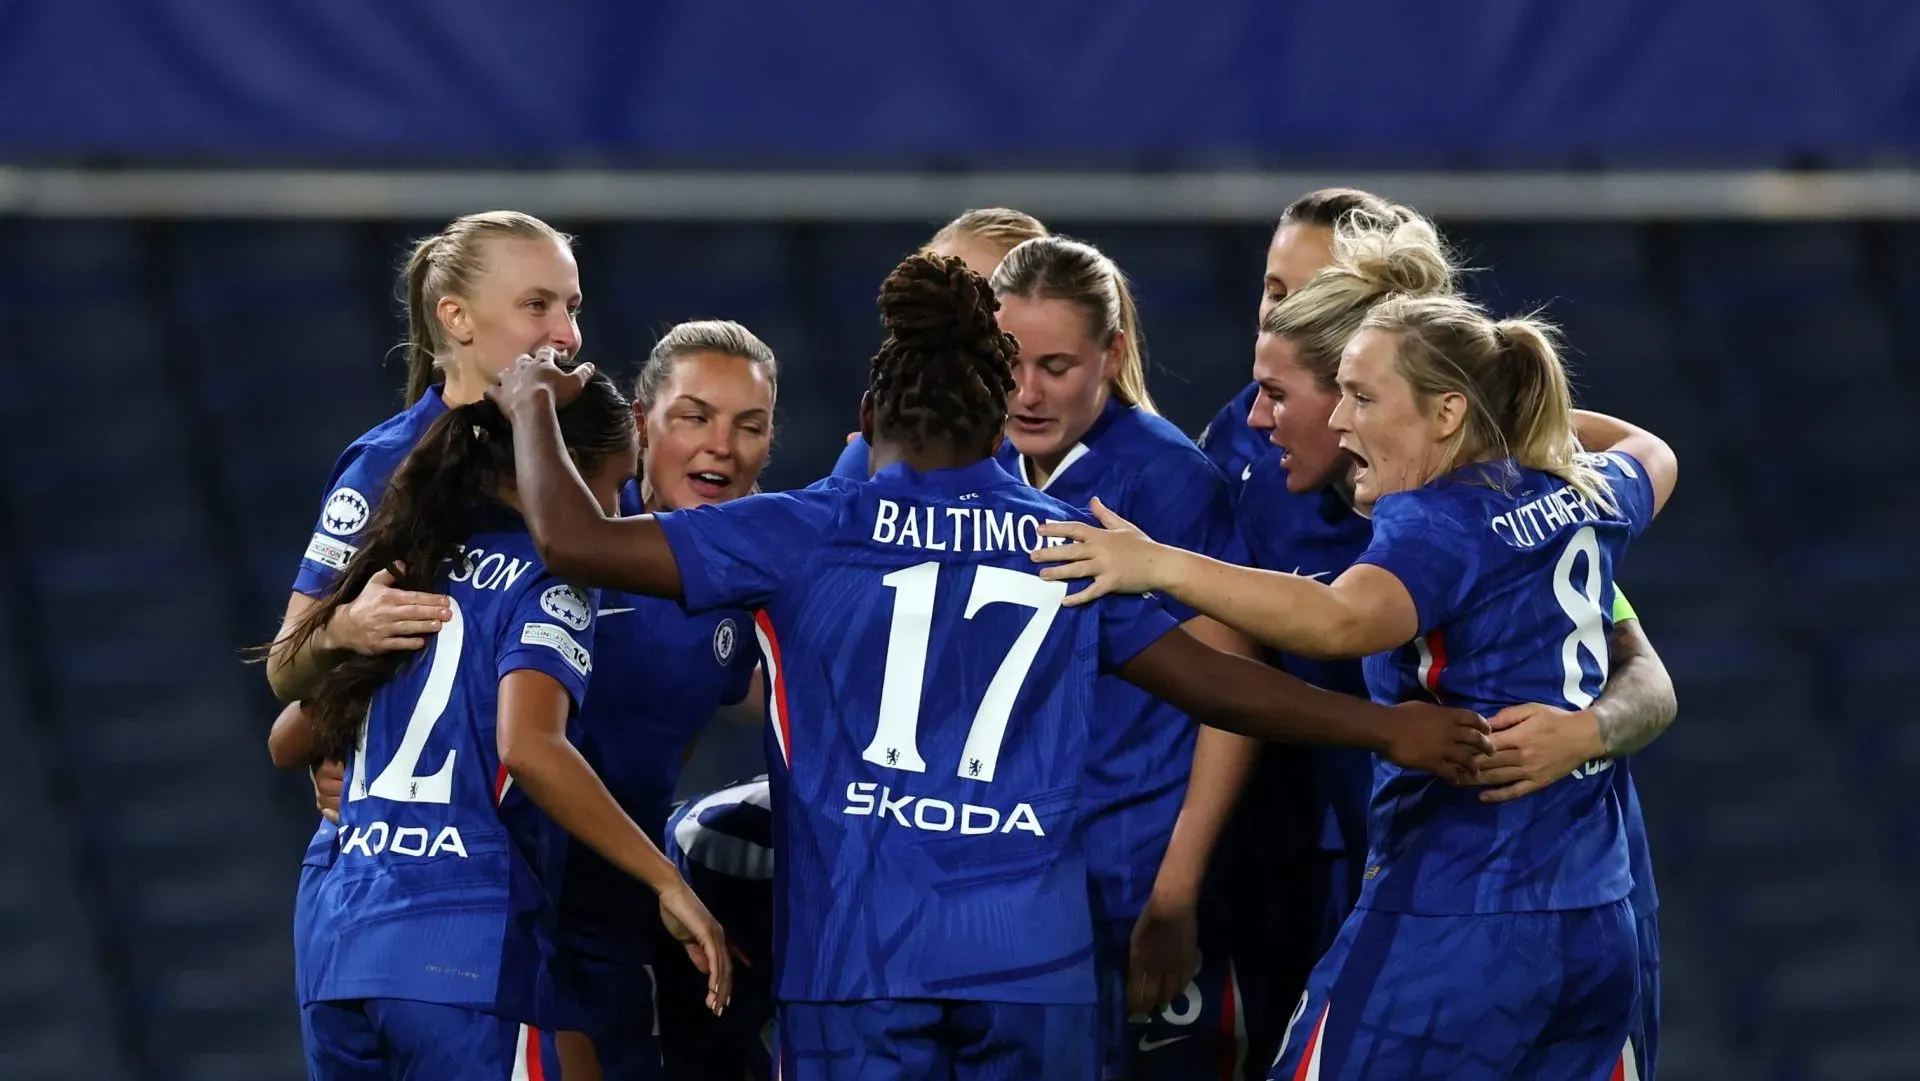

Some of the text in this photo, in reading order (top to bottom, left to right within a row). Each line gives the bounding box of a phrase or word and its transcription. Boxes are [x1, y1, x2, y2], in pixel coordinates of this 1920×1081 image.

[447, 544, 533, 592] SON
[1491, 484, 1601, 548] CUTHBER
[862, 561, 1068, 783] 17
[1553, 526, 1610, 710] 8
